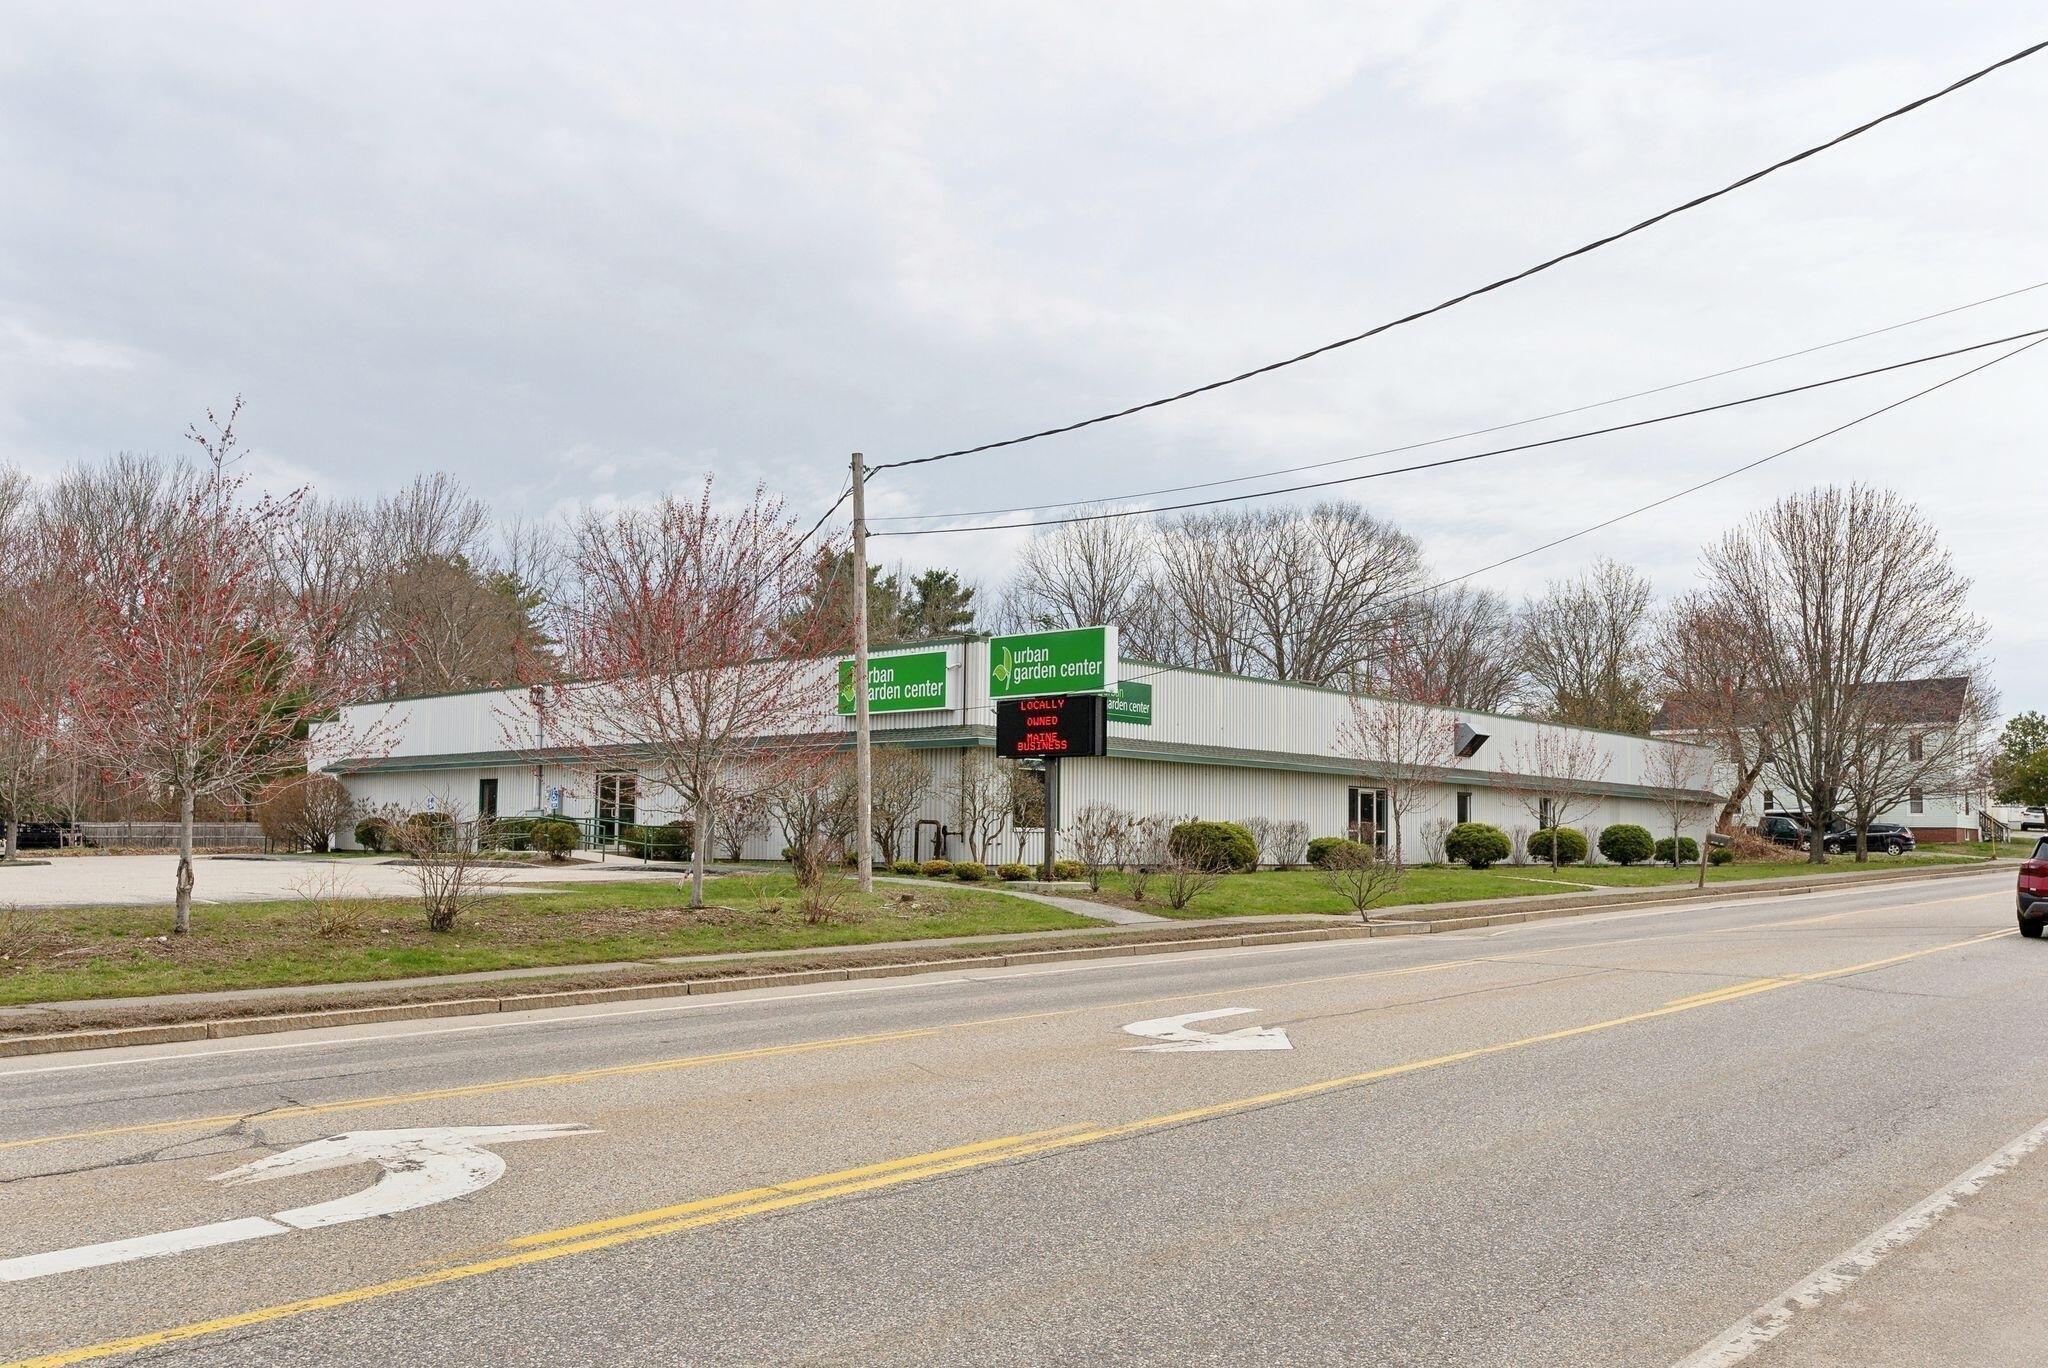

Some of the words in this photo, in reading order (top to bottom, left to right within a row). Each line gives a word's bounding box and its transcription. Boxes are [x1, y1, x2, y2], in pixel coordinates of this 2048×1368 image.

[1013, 646, 1049, 664] urban
[868, 666, 894, 684] rban
[1013, 663, 1056, 684] garden
[1060, 659, 1103, 677] center
[868, 684, 901, 701] arden
[904, 680, 944, 698] center
[1020, 699, 1065, 711] LOCALLY
[1107, 698, 1128, 711] arden
[1129, 701, 1150, 714] center
[1026, 716, 1058, 726] OWNED
[1026, 732, 1058, 742] MAINE
[1017, 740, 1068, 751] BUSINESS
